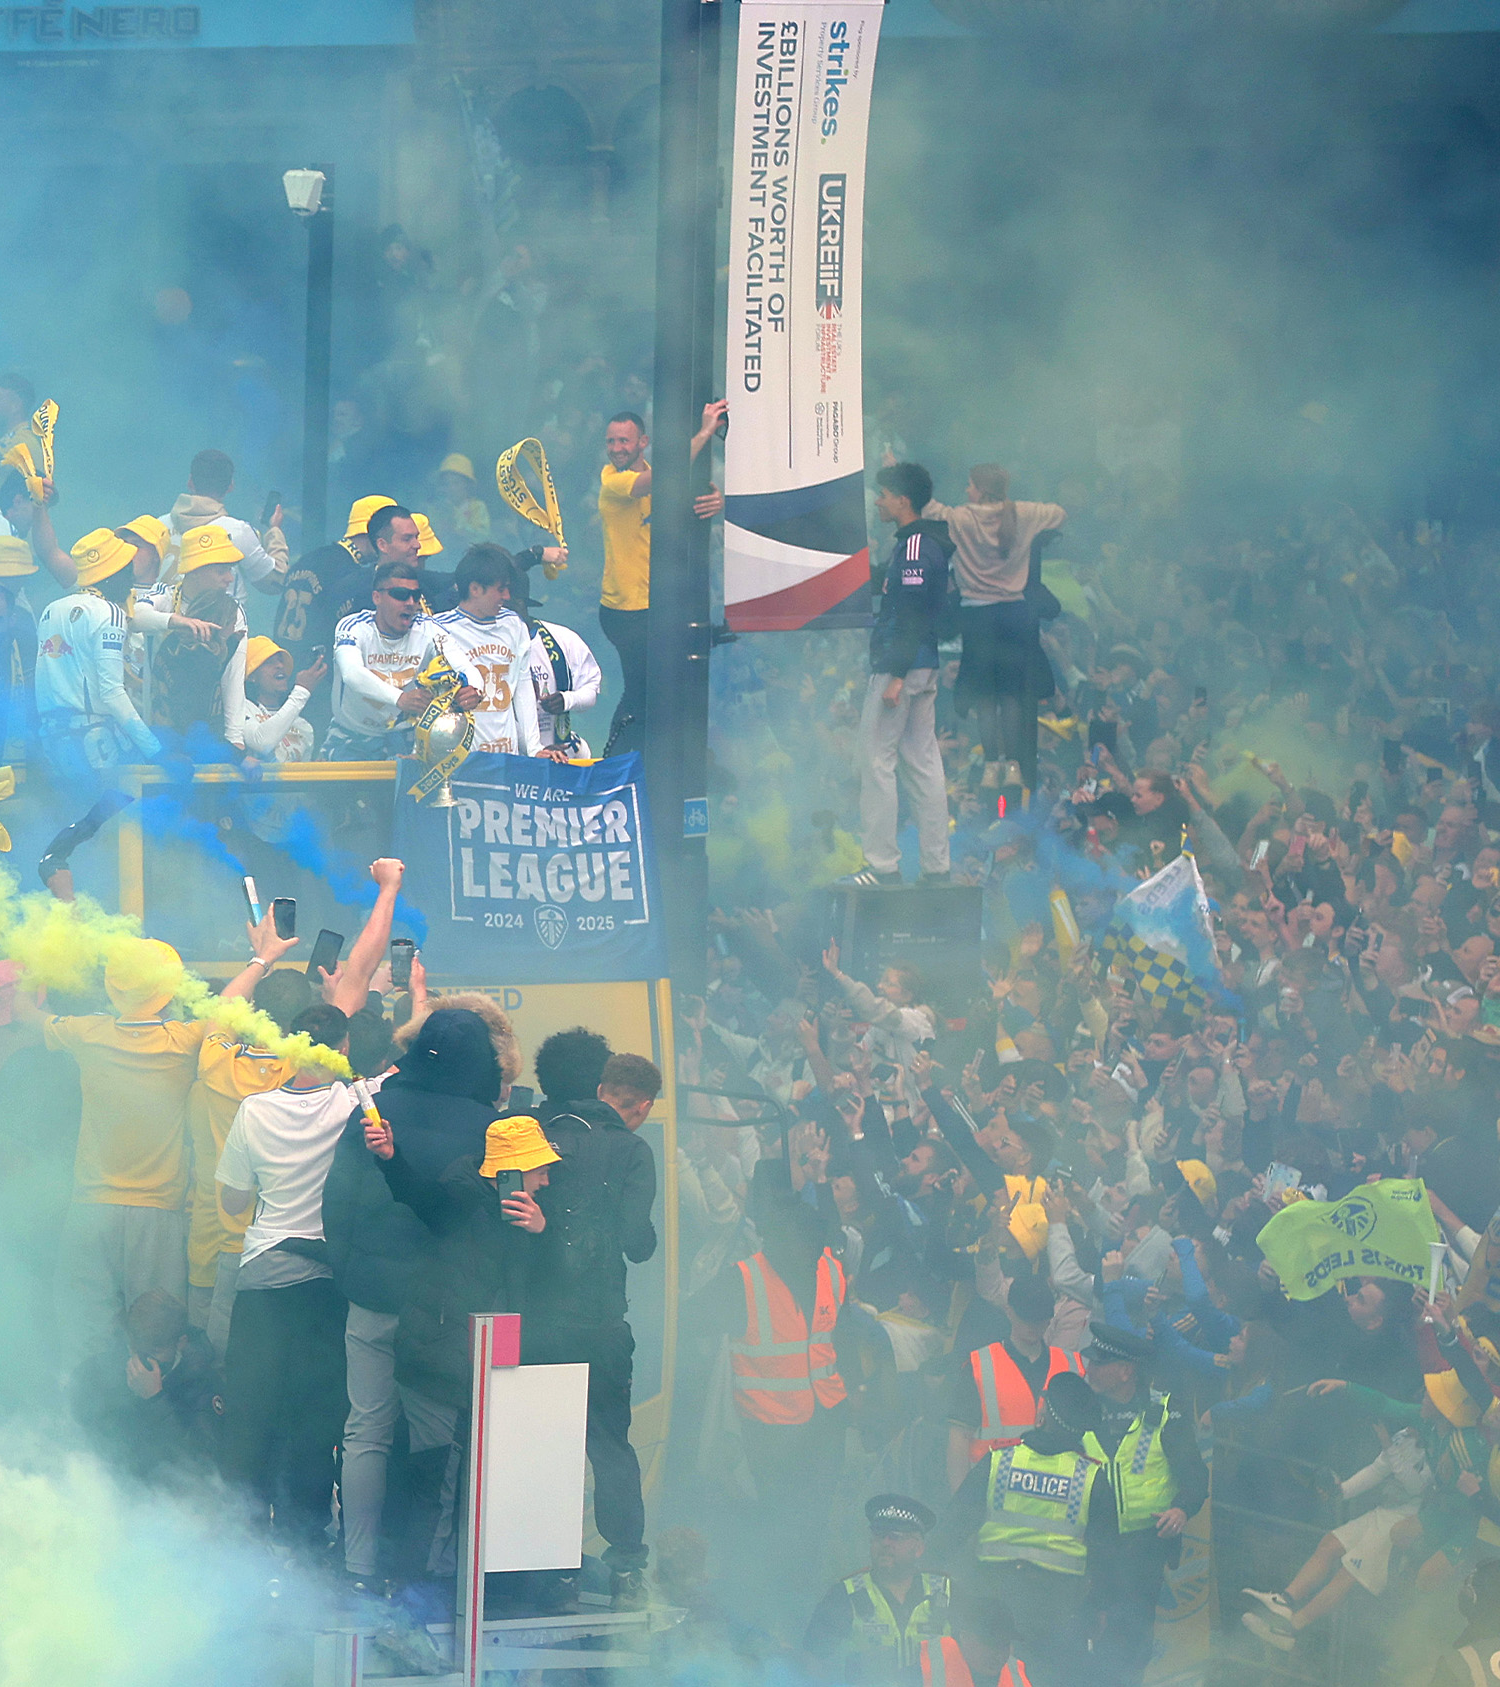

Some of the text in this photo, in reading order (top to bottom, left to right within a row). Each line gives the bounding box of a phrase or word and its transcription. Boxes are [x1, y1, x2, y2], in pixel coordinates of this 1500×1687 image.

[811, 21, 828, 124] Property Services Group
[767, 21, 798, 333] £BILLIONS WORTH OF
[744, 22, 776, 393] INVESTMENT FACILITATED
[515, 783, 574, 802] WE ARE
[457, 797, 631, 848] PREMIER
[461, 847, 634, 903] LEAGUE
[484, 913, 615, 931] 2024 2025
[1010, 1472, 1069, 1497] POLICE
